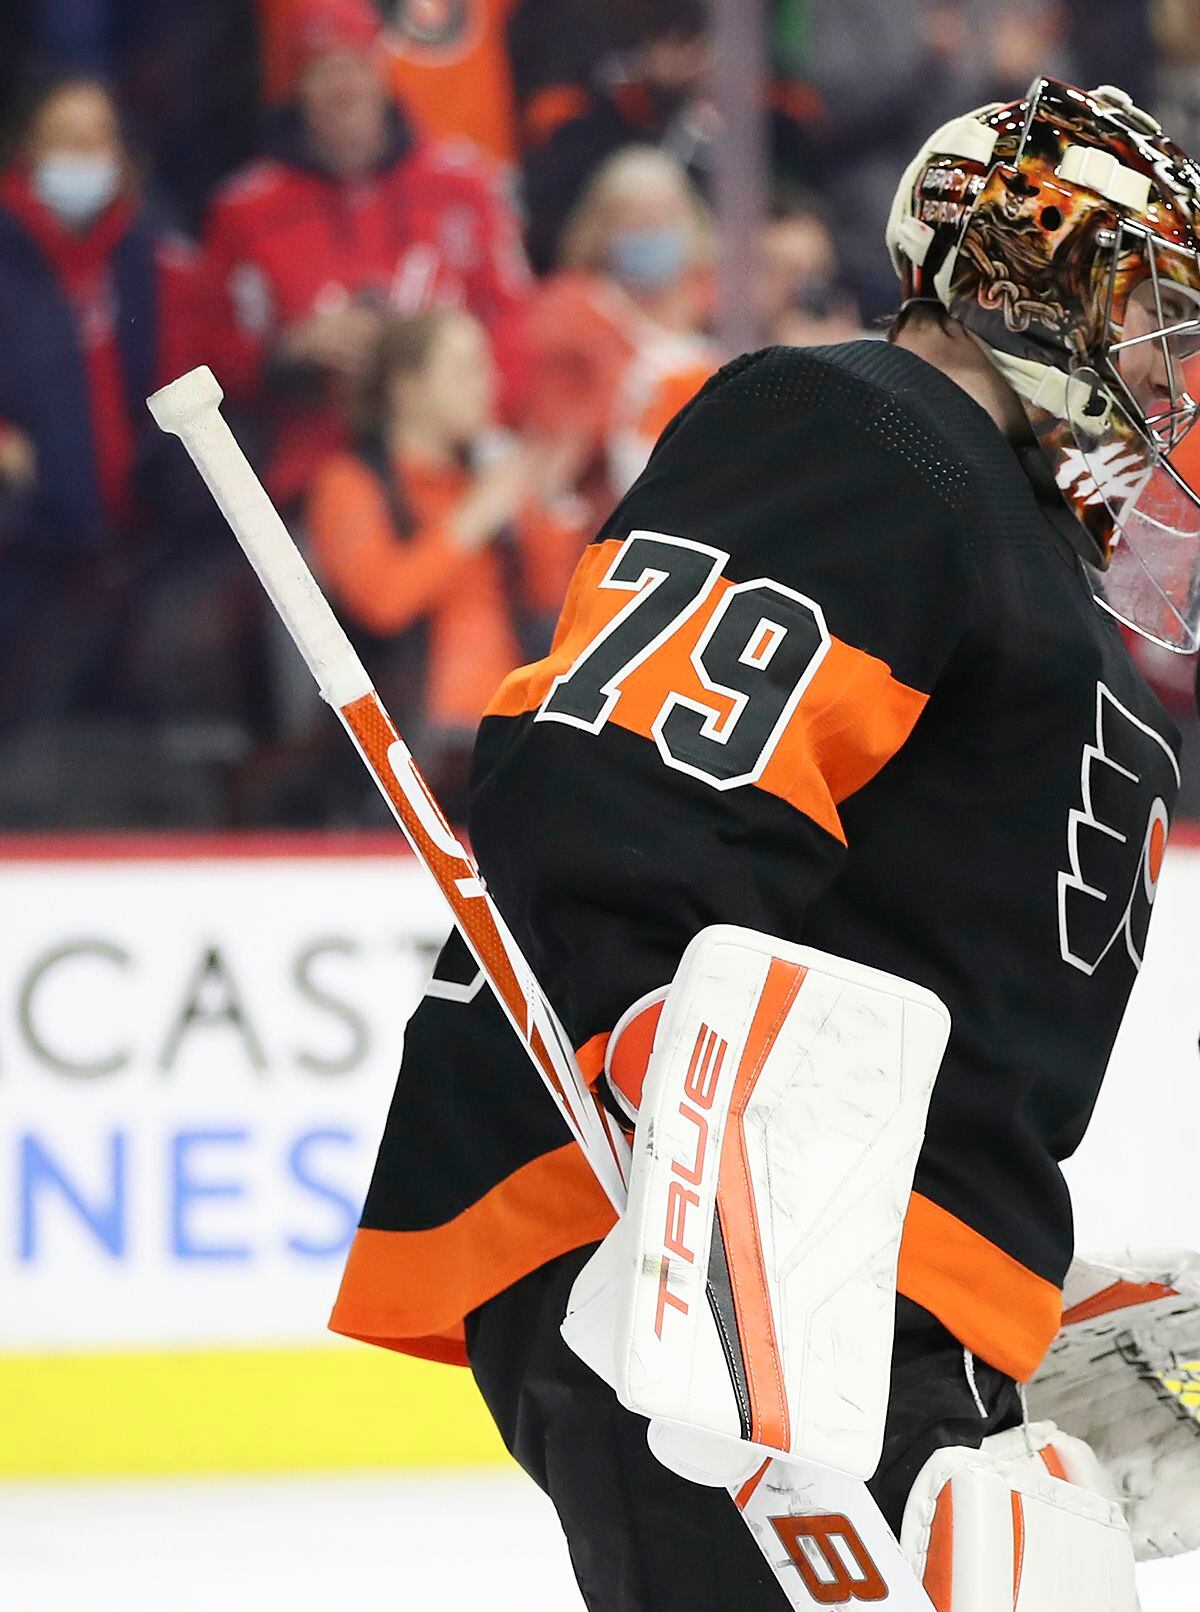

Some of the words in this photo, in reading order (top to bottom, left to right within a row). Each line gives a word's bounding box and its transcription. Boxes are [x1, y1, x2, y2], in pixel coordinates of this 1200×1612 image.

[534, 530, 832, 791] 79
[17, 1126, 361, 1262] NES
[655, 1023, 728, 1341] TRUE
